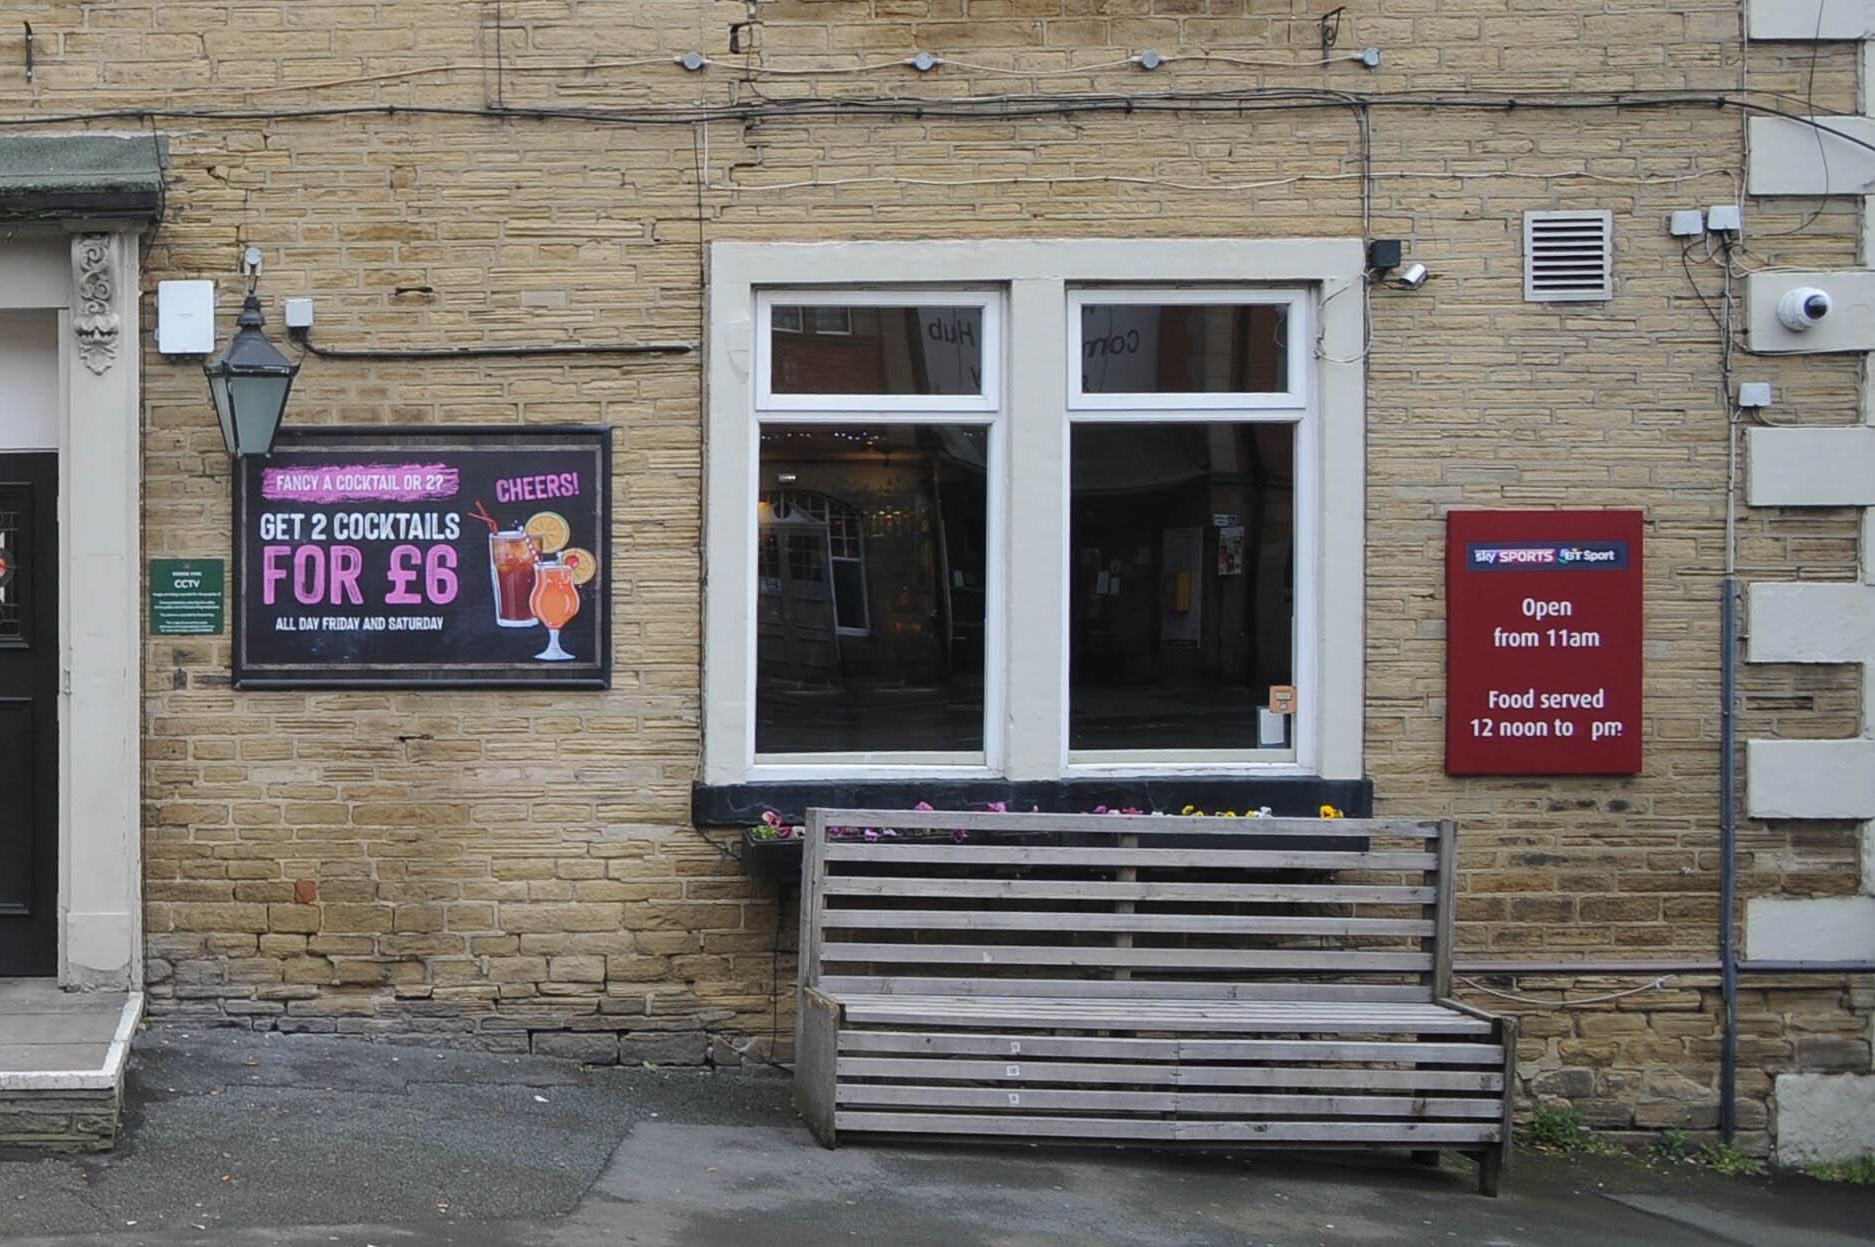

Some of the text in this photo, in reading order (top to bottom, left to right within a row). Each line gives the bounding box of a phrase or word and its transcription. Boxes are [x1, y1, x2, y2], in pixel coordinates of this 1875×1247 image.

[277, 474, 444, 491] FANCY A COCKTAIL OR 2?
[495, 472, 580, 503] CHEERS!
[260, 512, 460, 540] GET 2 COCKTAILS
[1476, 550, 1495, 563] sky
[1499, 551, 1554, 563] SPORTS
[1583, 551, 1615, 562] Sport
[174, 579, 200, 588] CCTV
[263, 543, 458, 605] FOR £6
[1522, 598, 1572, 620] Open
[276, 616, 444, 630] ALL DAY FRIDAY AND SATURDAY
[1494, 627, 1600, 647] from 11am
[1488, 688, 1604, 709] Food served
[1470, 718, 1493, 736] 12
[1499, 721, 1548, 736] noon
[1553, 718, 1574, 736] to
